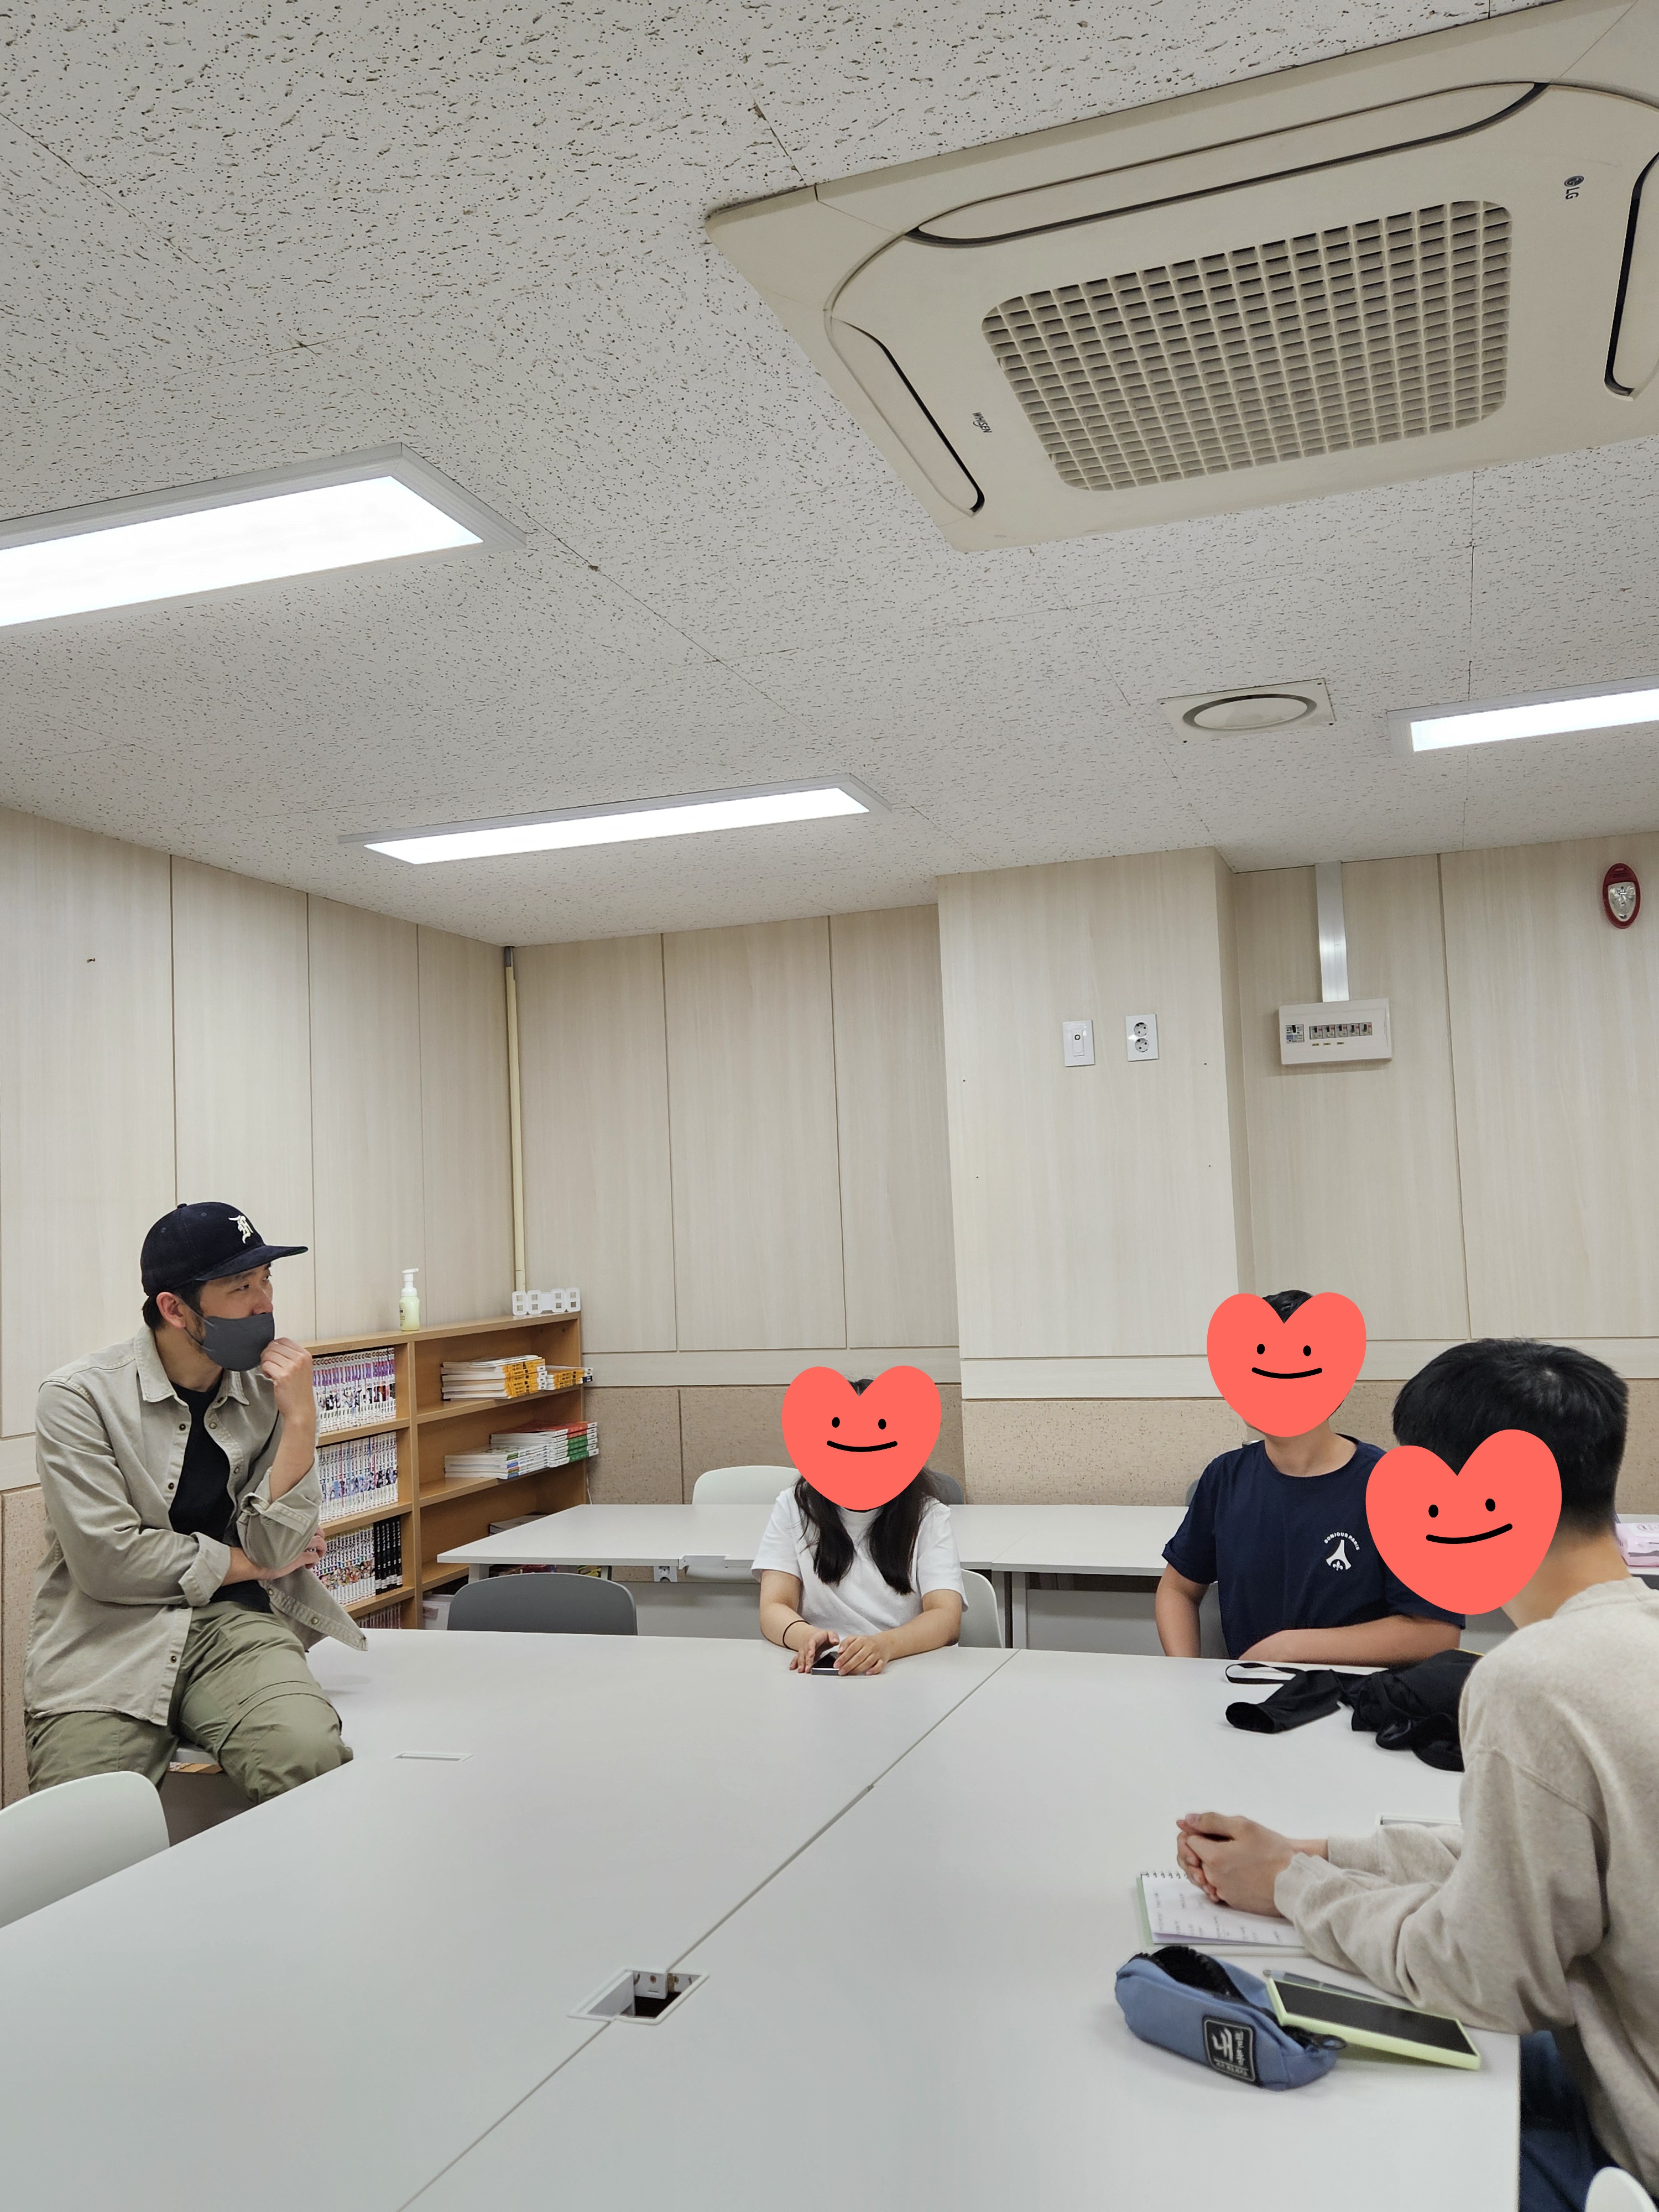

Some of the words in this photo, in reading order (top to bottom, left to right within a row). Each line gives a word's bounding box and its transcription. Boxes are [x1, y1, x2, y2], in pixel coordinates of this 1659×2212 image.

[1565, 186, 1580, 200] LG
[972, 411, 993, 434] WHISEN
[1324, 1532, 1348, 1544] BONJOUR
